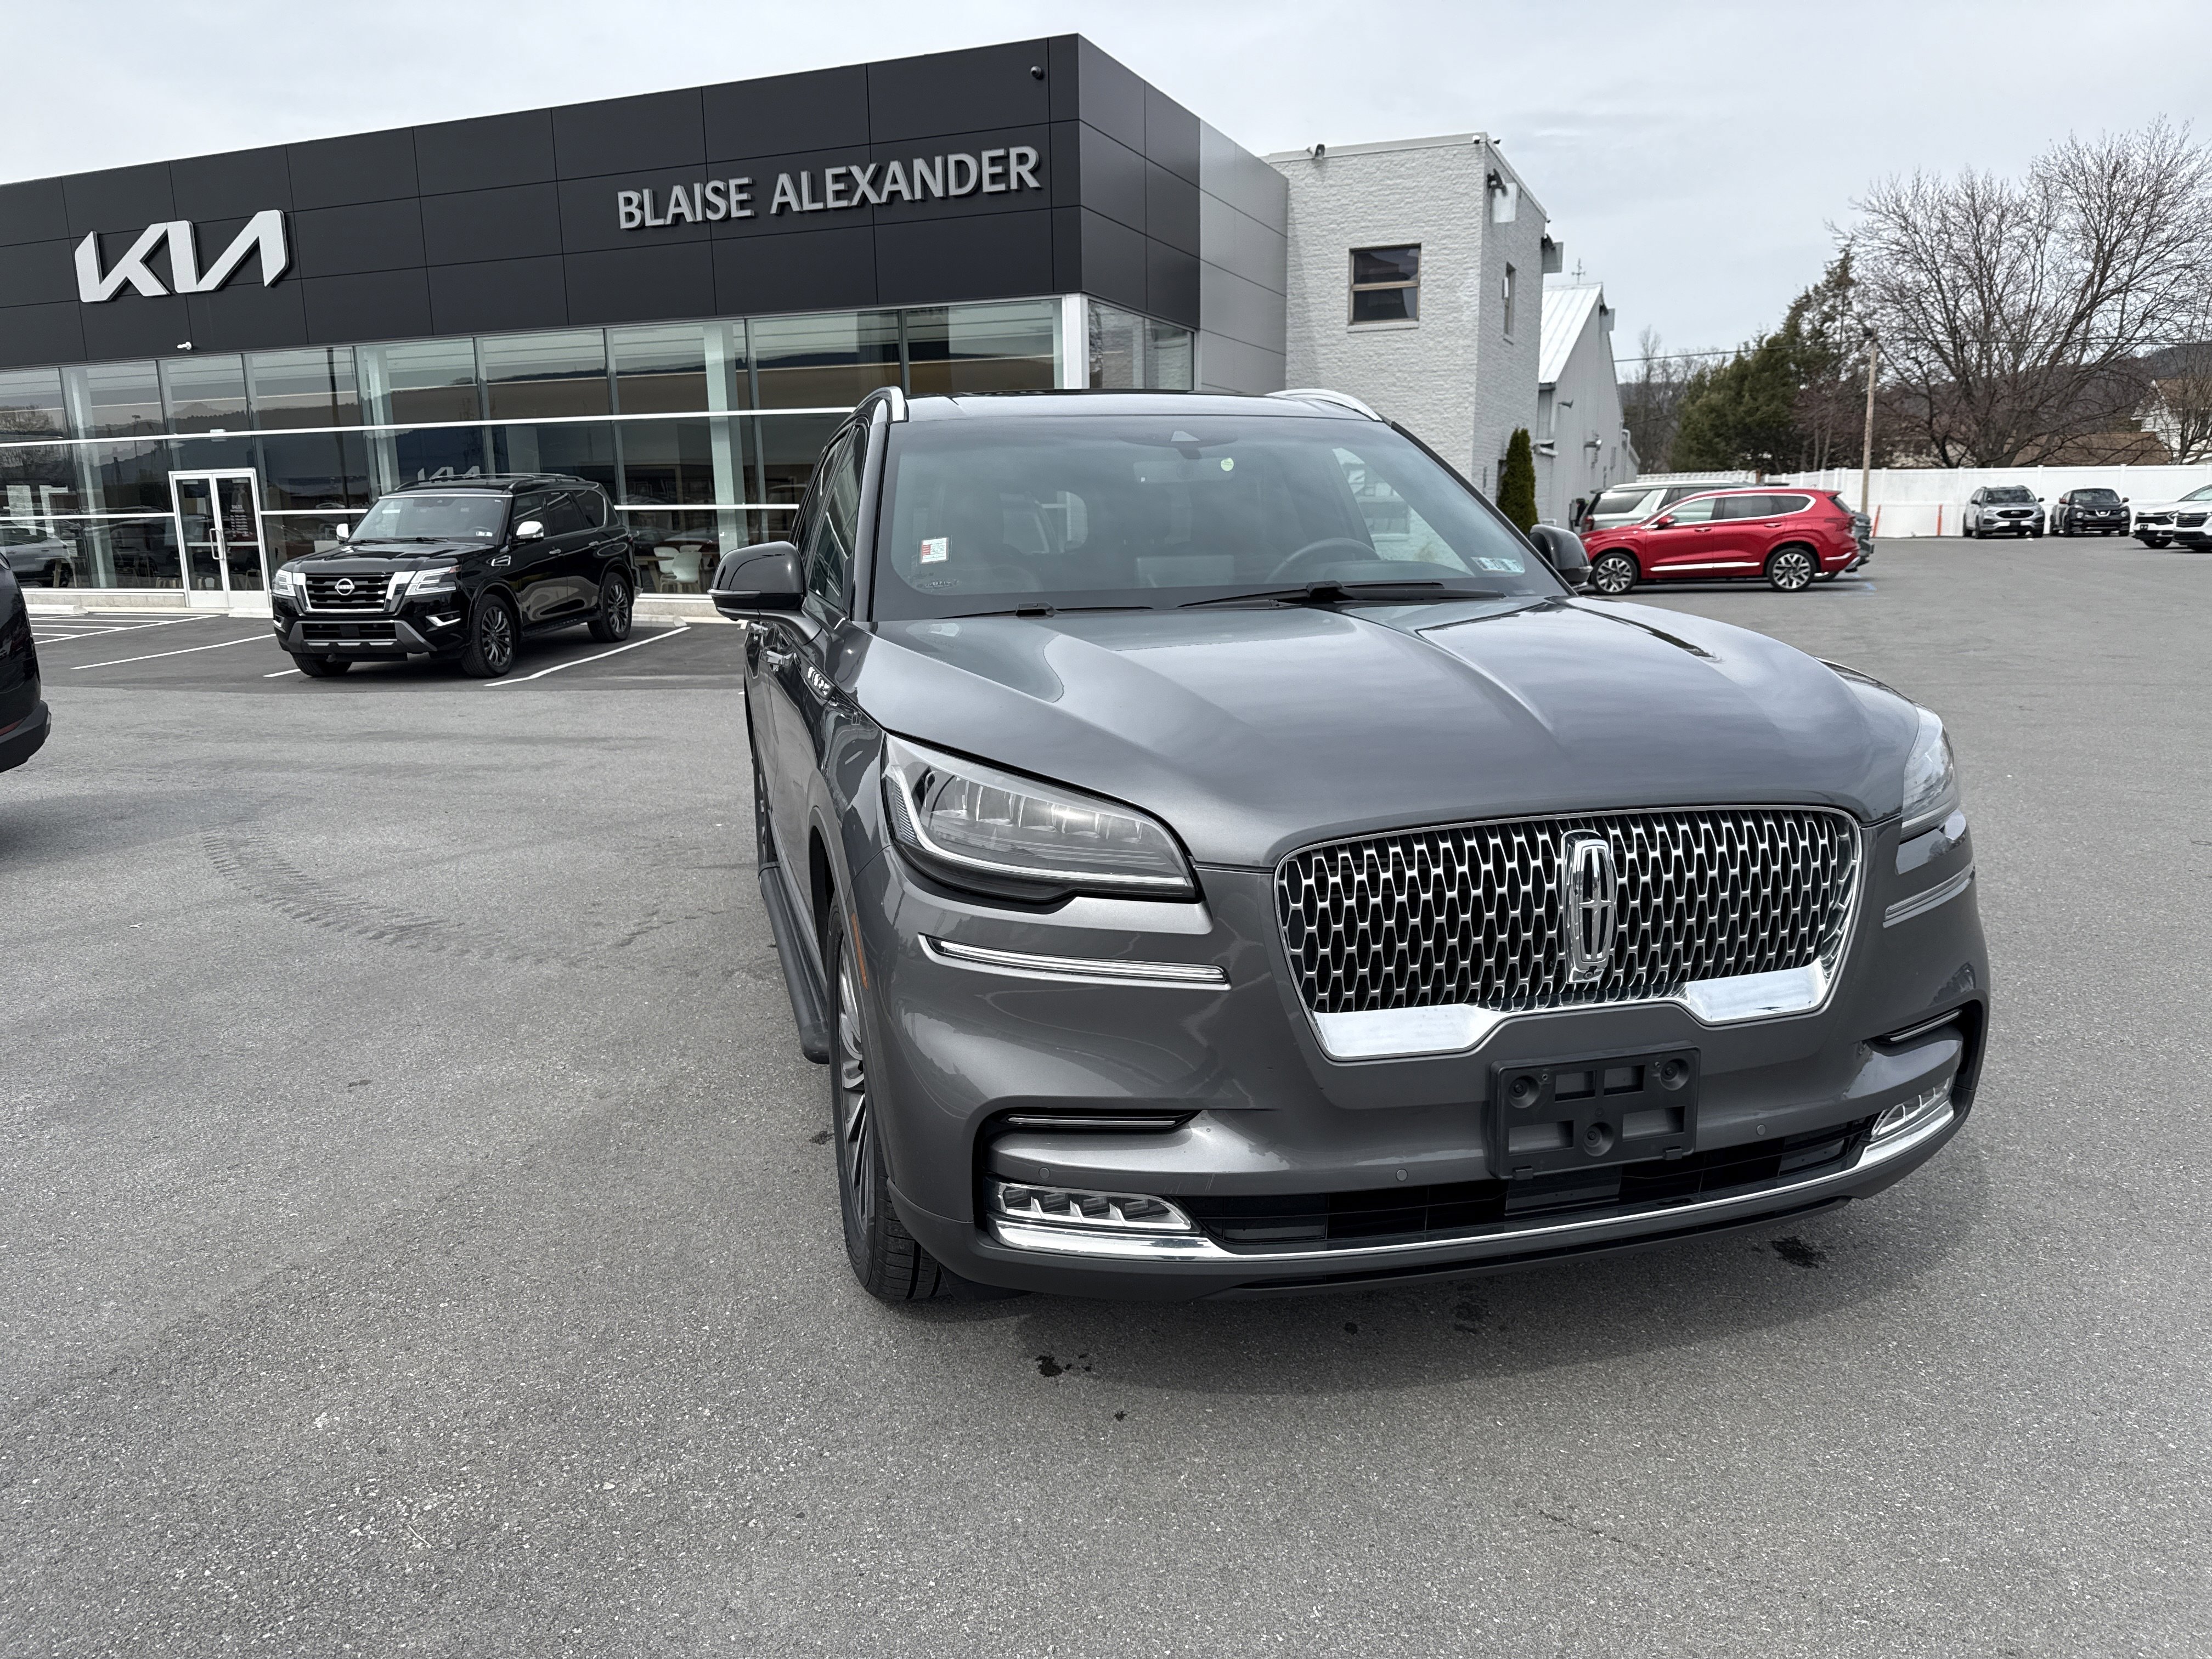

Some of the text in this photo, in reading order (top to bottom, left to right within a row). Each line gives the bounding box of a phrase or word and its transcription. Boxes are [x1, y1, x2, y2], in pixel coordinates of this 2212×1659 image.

[617, 145, 1041, 229] BLAISE ALEXANDER
[75, 209, 289, 303] KIA
